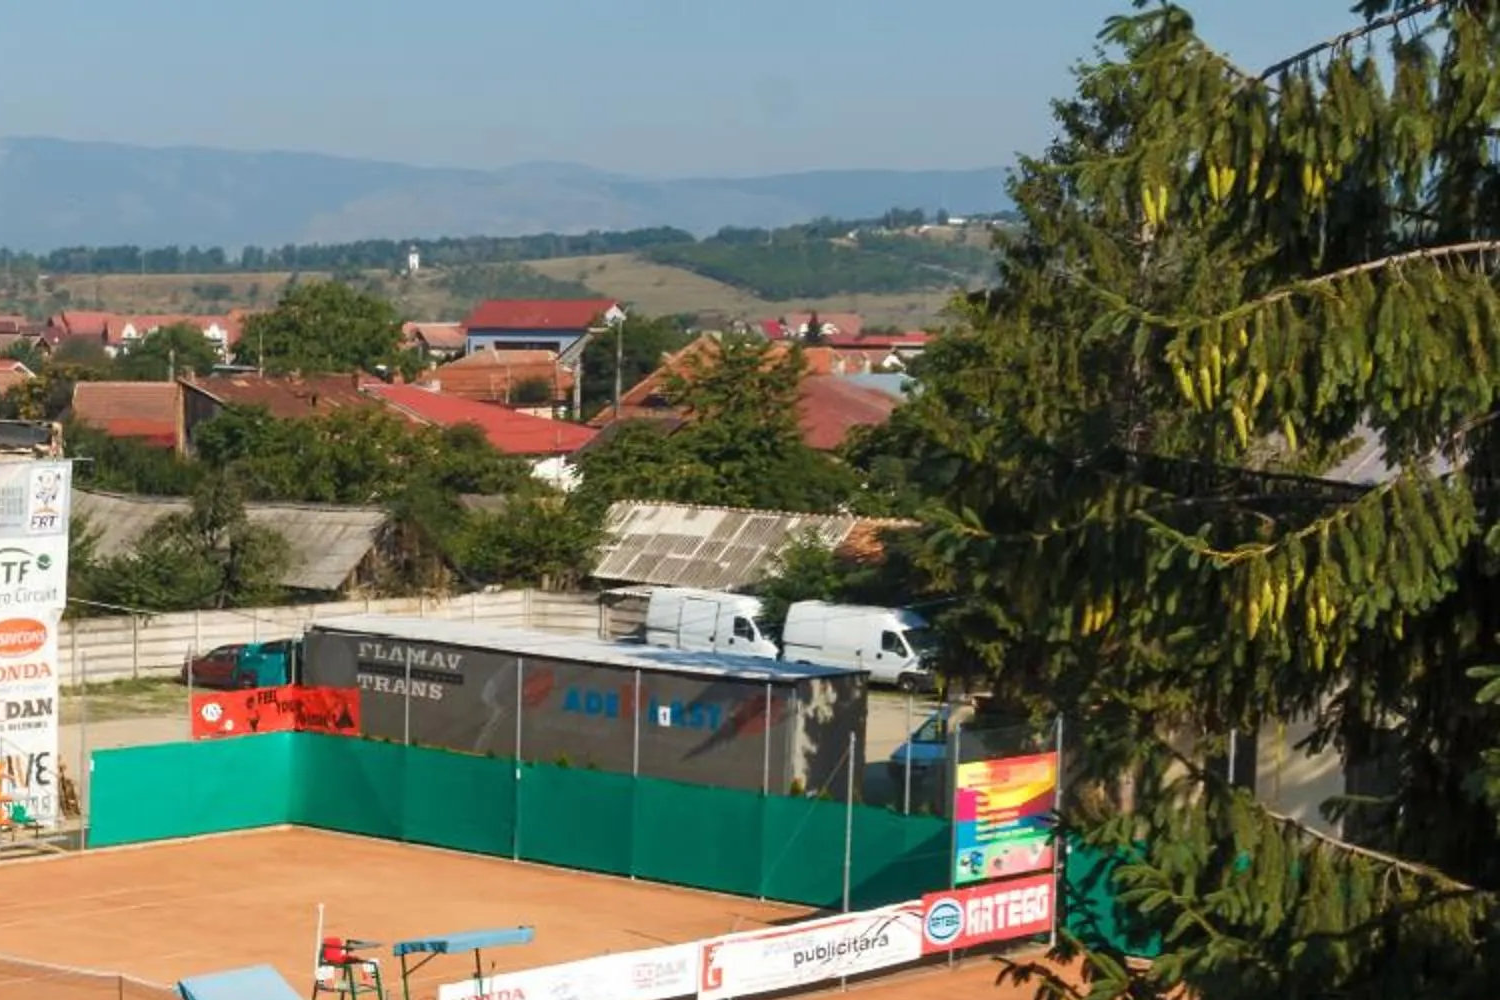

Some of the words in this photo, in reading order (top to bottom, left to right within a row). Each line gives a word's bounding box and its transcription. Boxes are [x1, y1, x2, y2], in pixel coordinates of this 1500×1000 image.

[31, 515, 58, 530] FRT
[14, 587, 58, 604] Circuit
[357, 643, 463, 670] FLAMAV
[356, 674, 444, 701] TRANS
[966, 883, 1048, 936] ARTEGO
